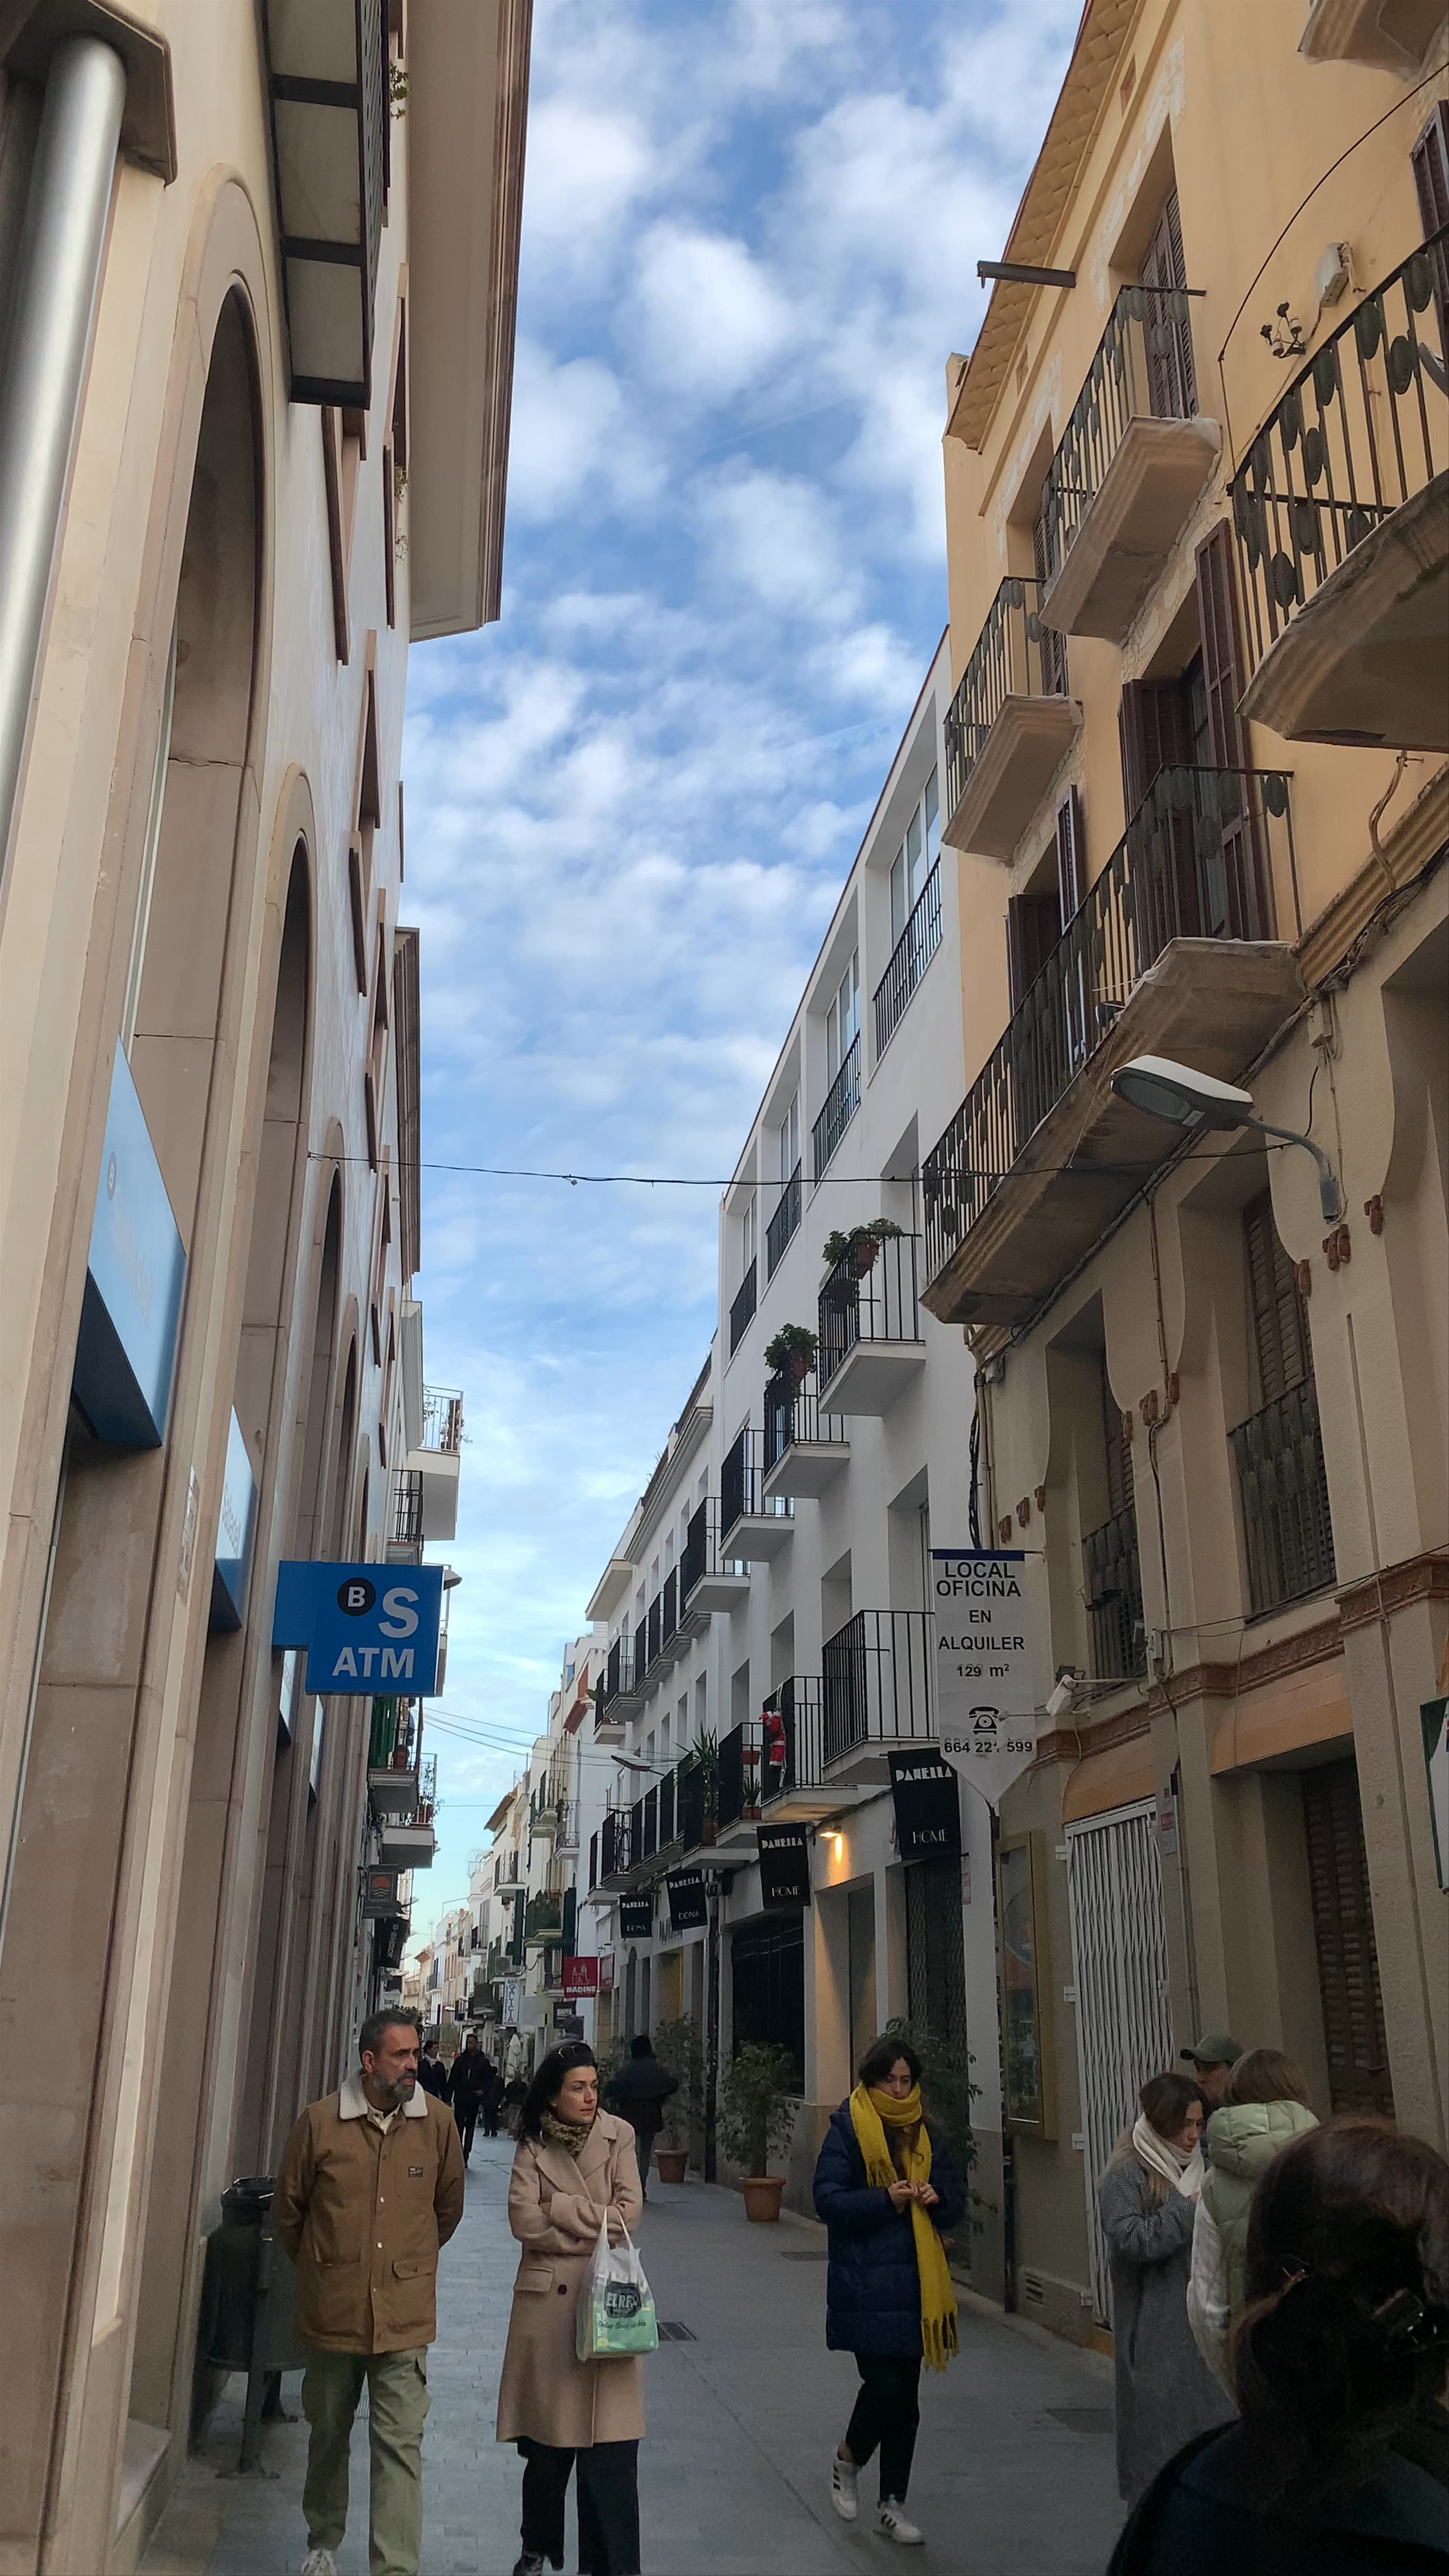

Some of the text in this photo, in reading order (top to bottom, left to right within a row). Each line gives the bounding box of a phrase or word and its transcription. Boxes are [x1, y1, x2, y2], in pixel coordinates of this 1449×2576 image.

[944, 1561, 1015, 1578] LOCAL
[936, 1580, 1021, 1597] OFICINA
[347, 1586, 419, 1638] B S
[970, 1610, 991, 1623] EN
[938, 1636, 1024, 1651] ALQUILER
[332, 1647, 414, 1678] ATM
[957, 1666, 981, 1677] 129
[944, 1741, 1032, 1753] 664 22 599
[895, 1766, 953, 1782] PANELLA
[761, 1837, 803, 1849] PANELLA
[912, 1829, 948, 1844] HOME
[669, 1876, 700, 1889] PANELLA
[772, 1885, 800, 1897] HOME
[678, 1910, 700, 1920] DONA
